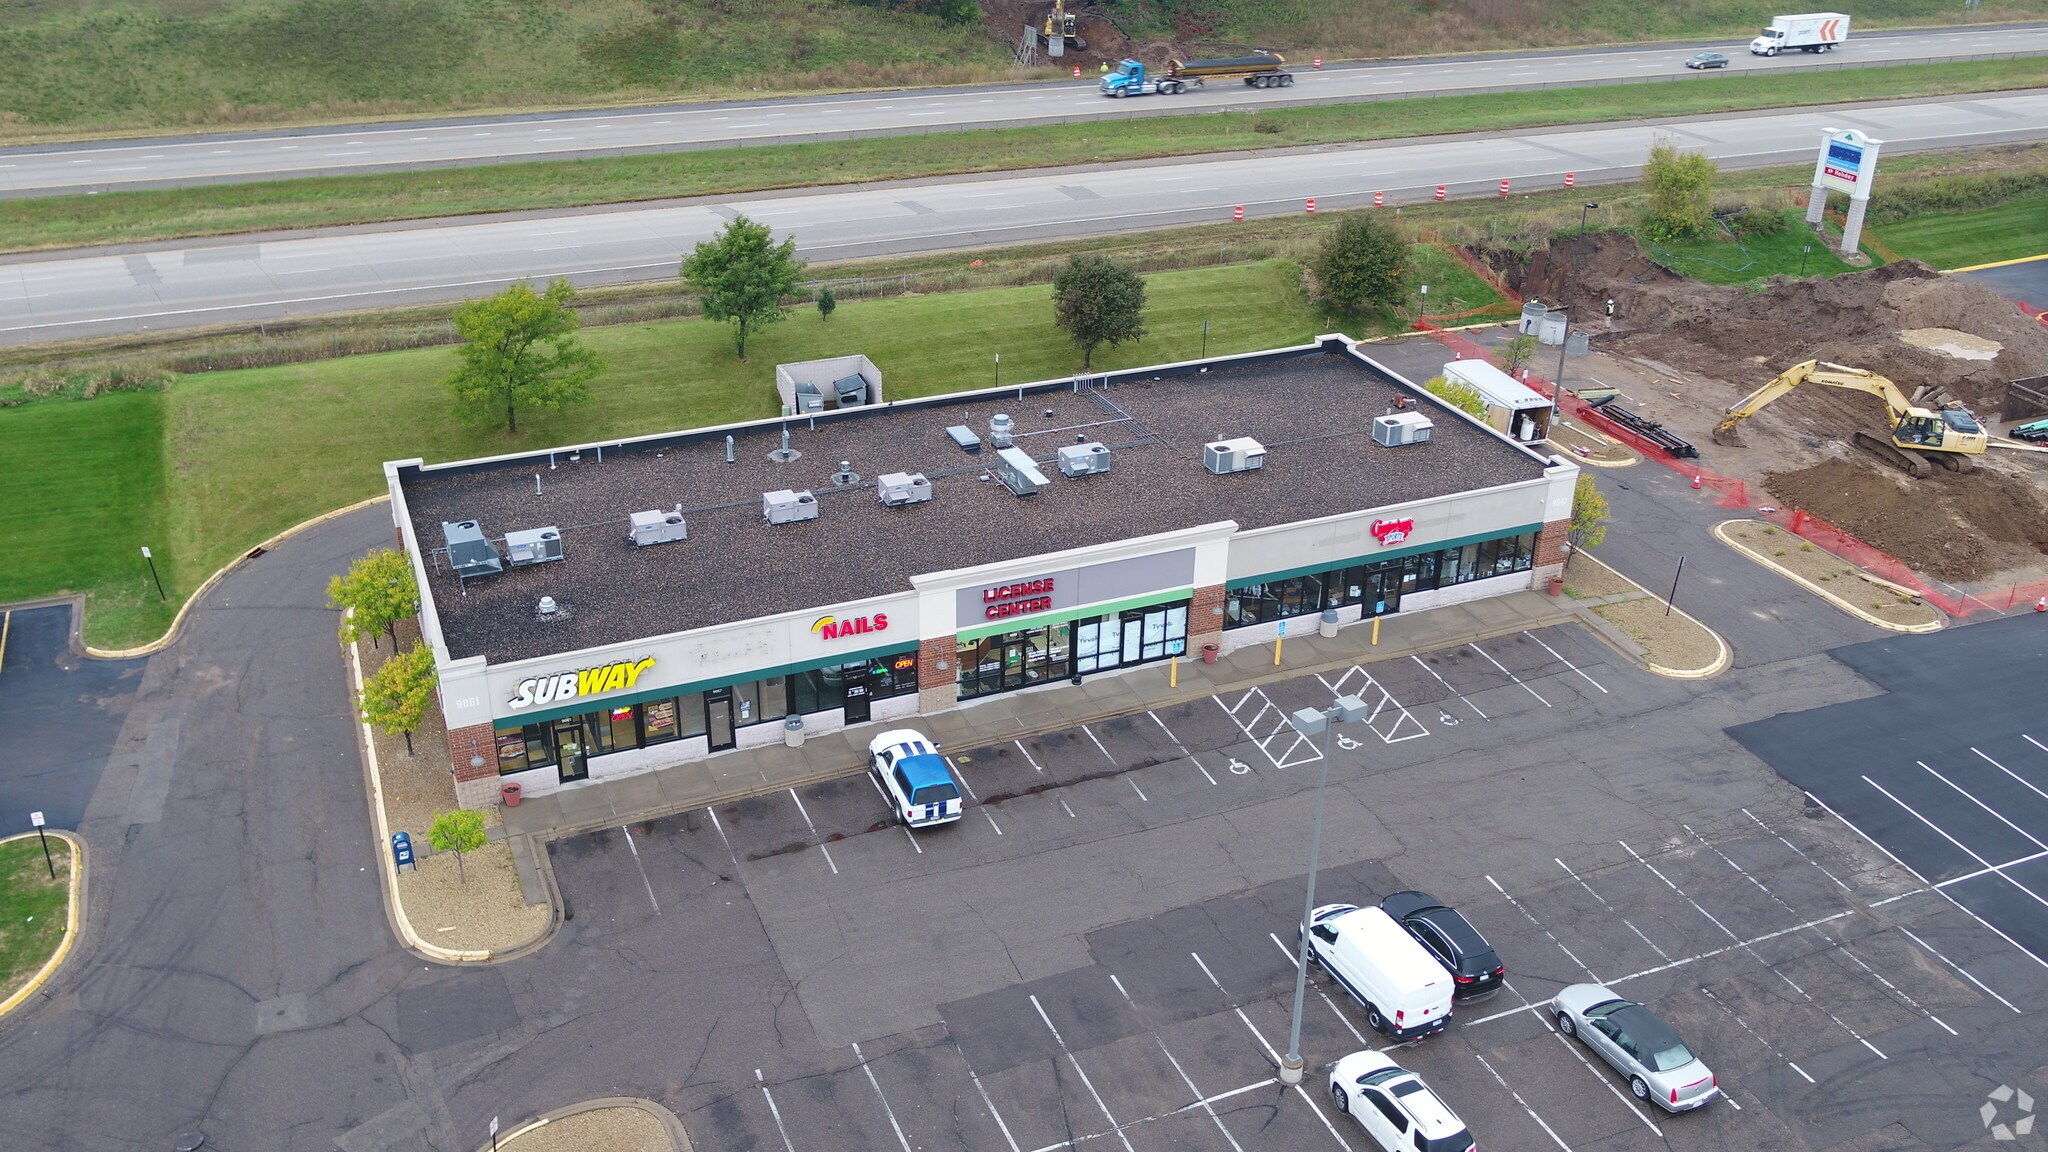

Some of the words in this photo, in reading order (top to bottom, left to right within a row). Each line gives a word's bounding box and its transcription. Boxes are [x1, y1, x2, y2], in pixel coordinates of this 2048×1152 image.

[1385, 531, 1404, 542] SPORTS
[984, 578, 1054, 603] LICENSE
[985, 596, 1052, 620] CENTER
[822, 613, 888, 640] NAILS
[895, 660, 913, 669] OPEN
[508, 656, 656, 710] SUBWAY
[456, 697, 479, 708] 9061
[611, 712, 634, 722] OPEN
